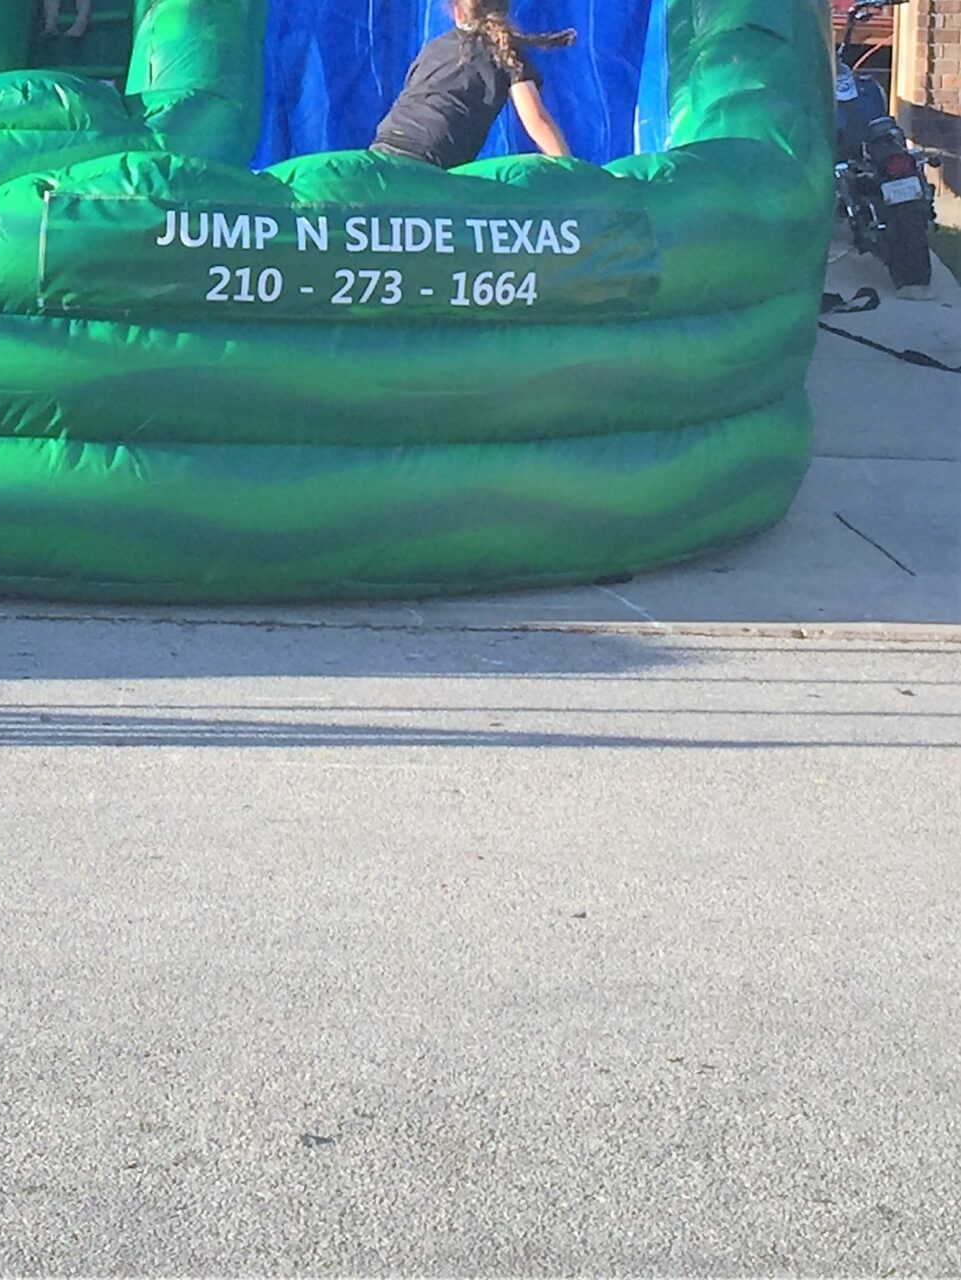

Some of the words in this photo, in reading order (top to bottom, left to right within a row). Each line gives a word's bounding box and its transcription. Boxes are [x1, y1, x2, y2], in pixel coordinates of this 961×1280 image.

[156, 210, 279, 249] JUMP
[297, 216, 329, 251] N
[345, 218, 455, 253] SLIDE
[466, 218, 581, 255] TEXAS
[205, 266, 284, 303] 210
[331, 269, 404, 306] 273
[450, 271, 538, 307] 1664
